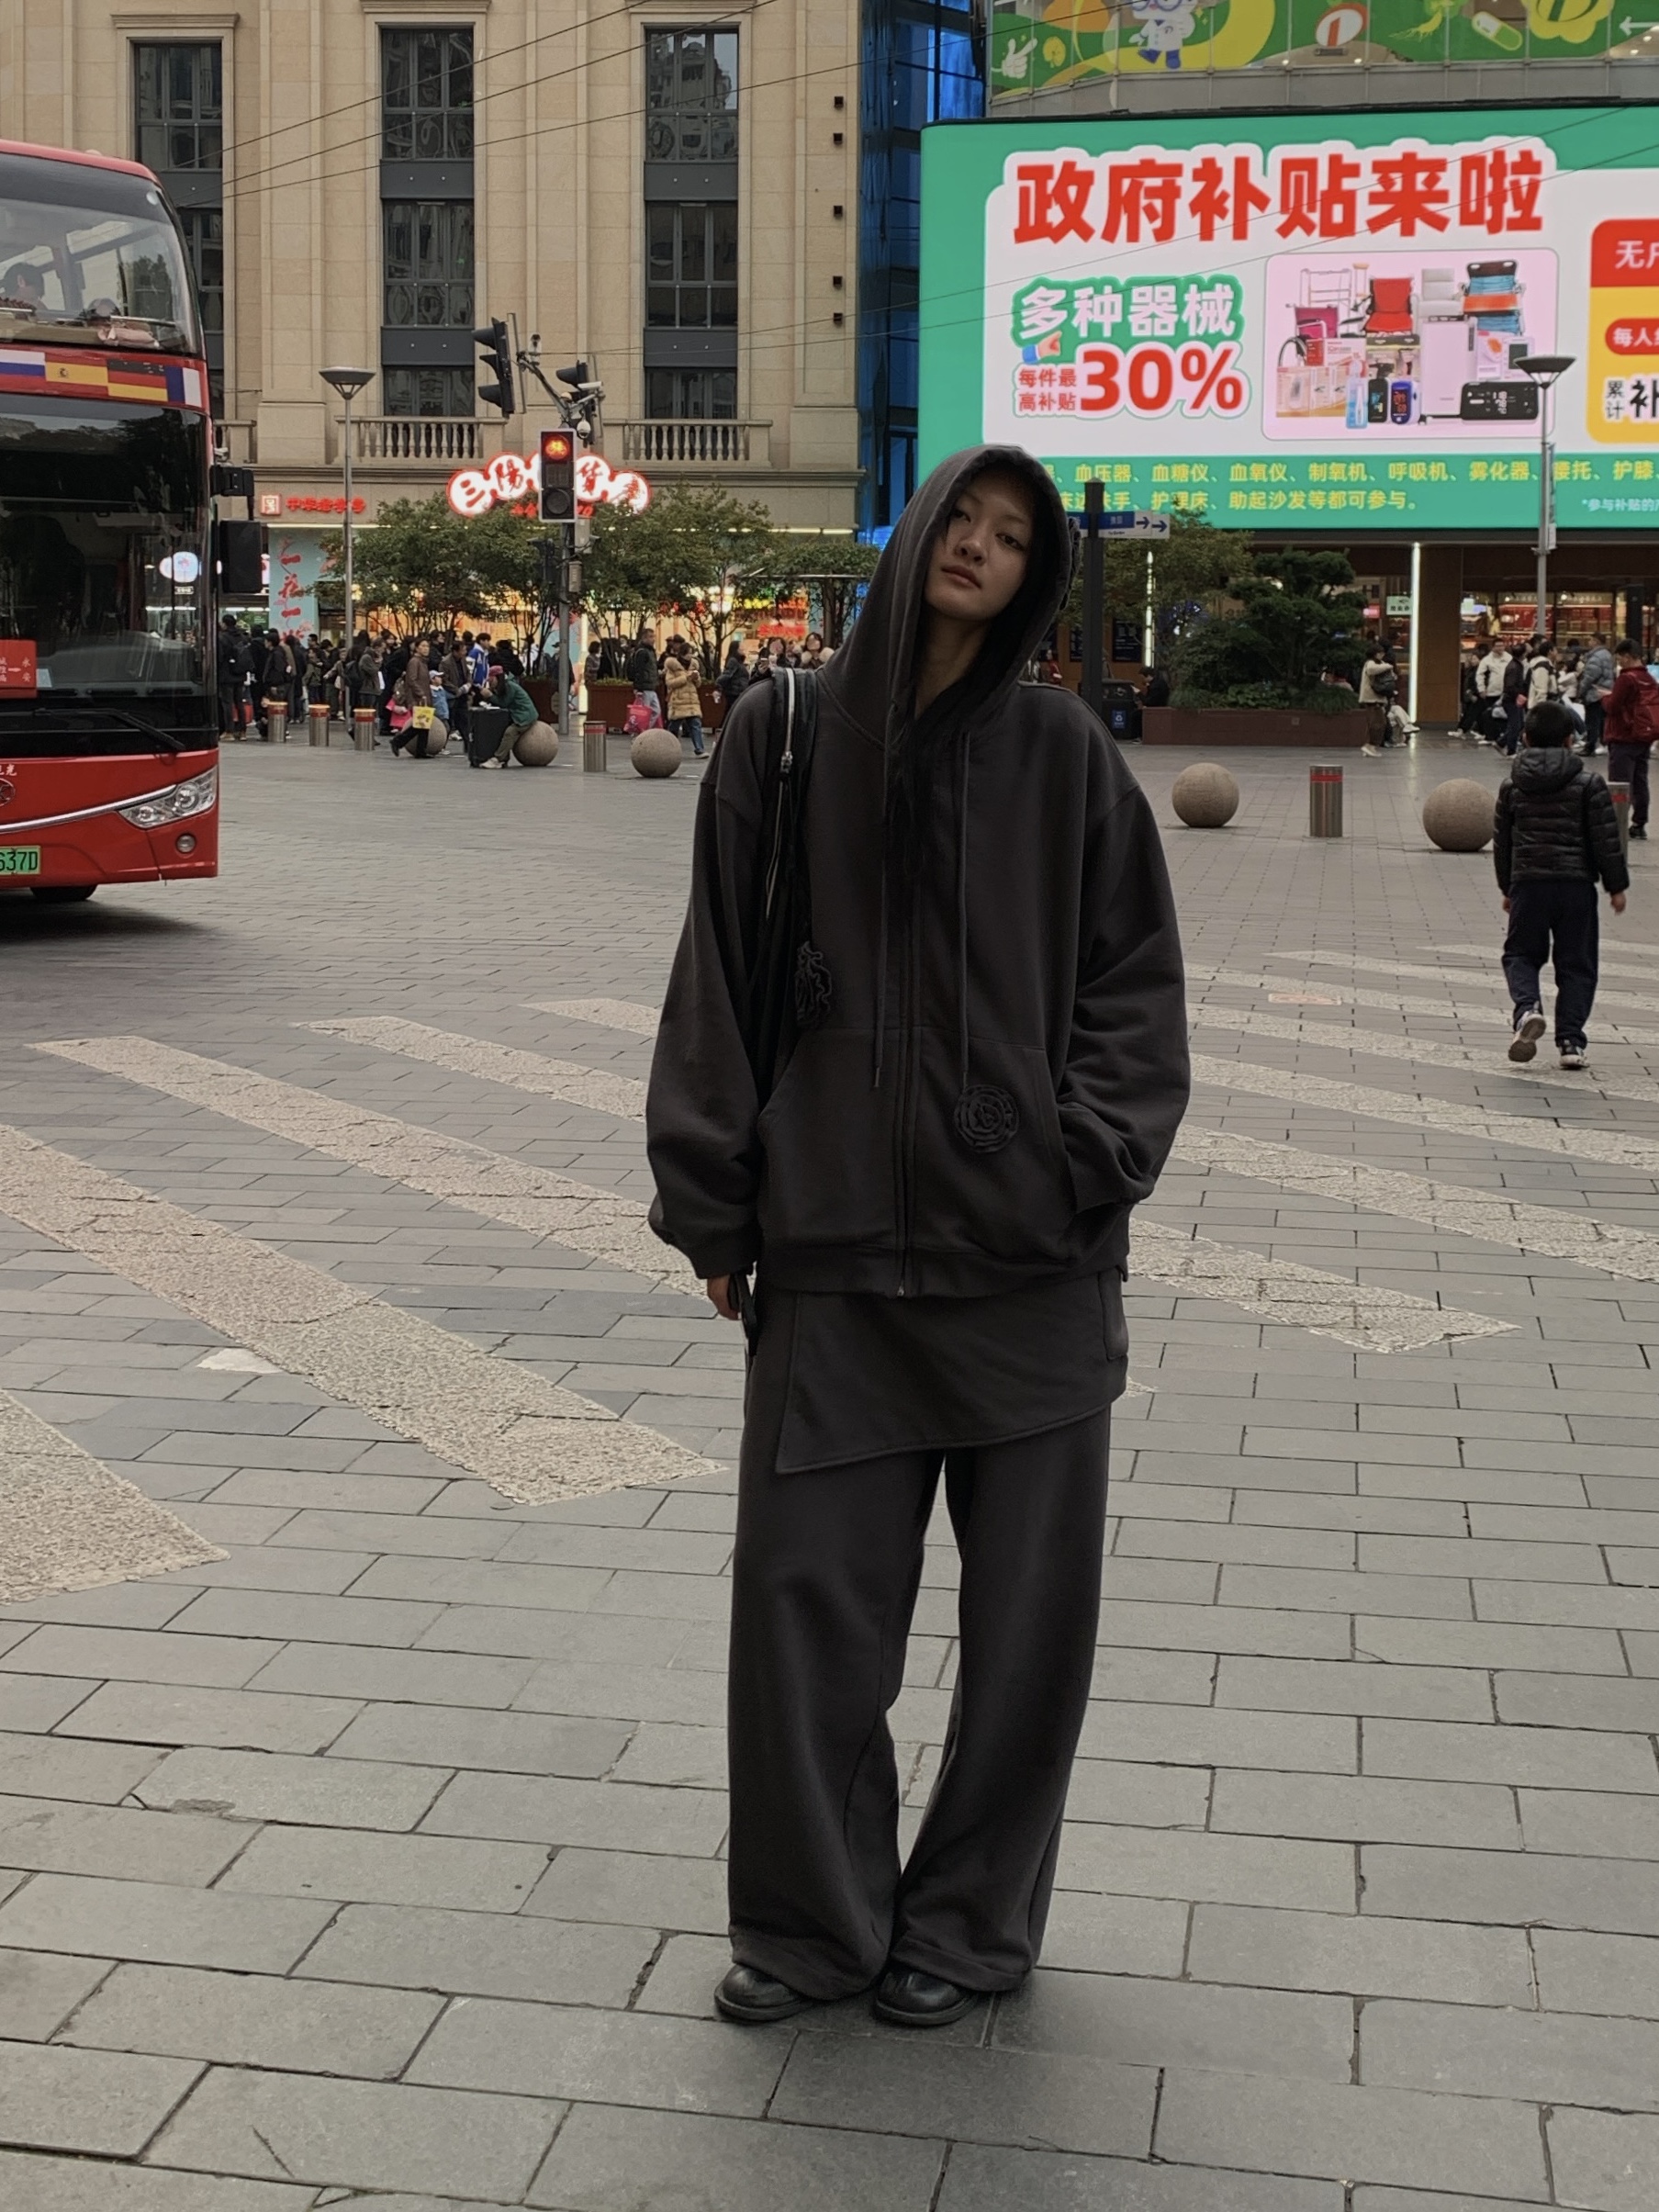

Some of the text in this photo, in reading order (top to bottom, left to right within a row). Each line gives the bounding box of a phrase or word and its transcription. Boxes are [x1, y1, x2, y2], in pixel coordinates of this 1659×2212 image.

[1014, 150, 1542, 244] 政府补贴来啦
[1019, 284, 1236, 340] 多种器械
[1613, 328, 1659, 348] 每人
[1018, 368, 1077, 388] 每件最
[1081, 349, 1242, 411] 30%
[1018, 392, 1077, 411] 高补贴
